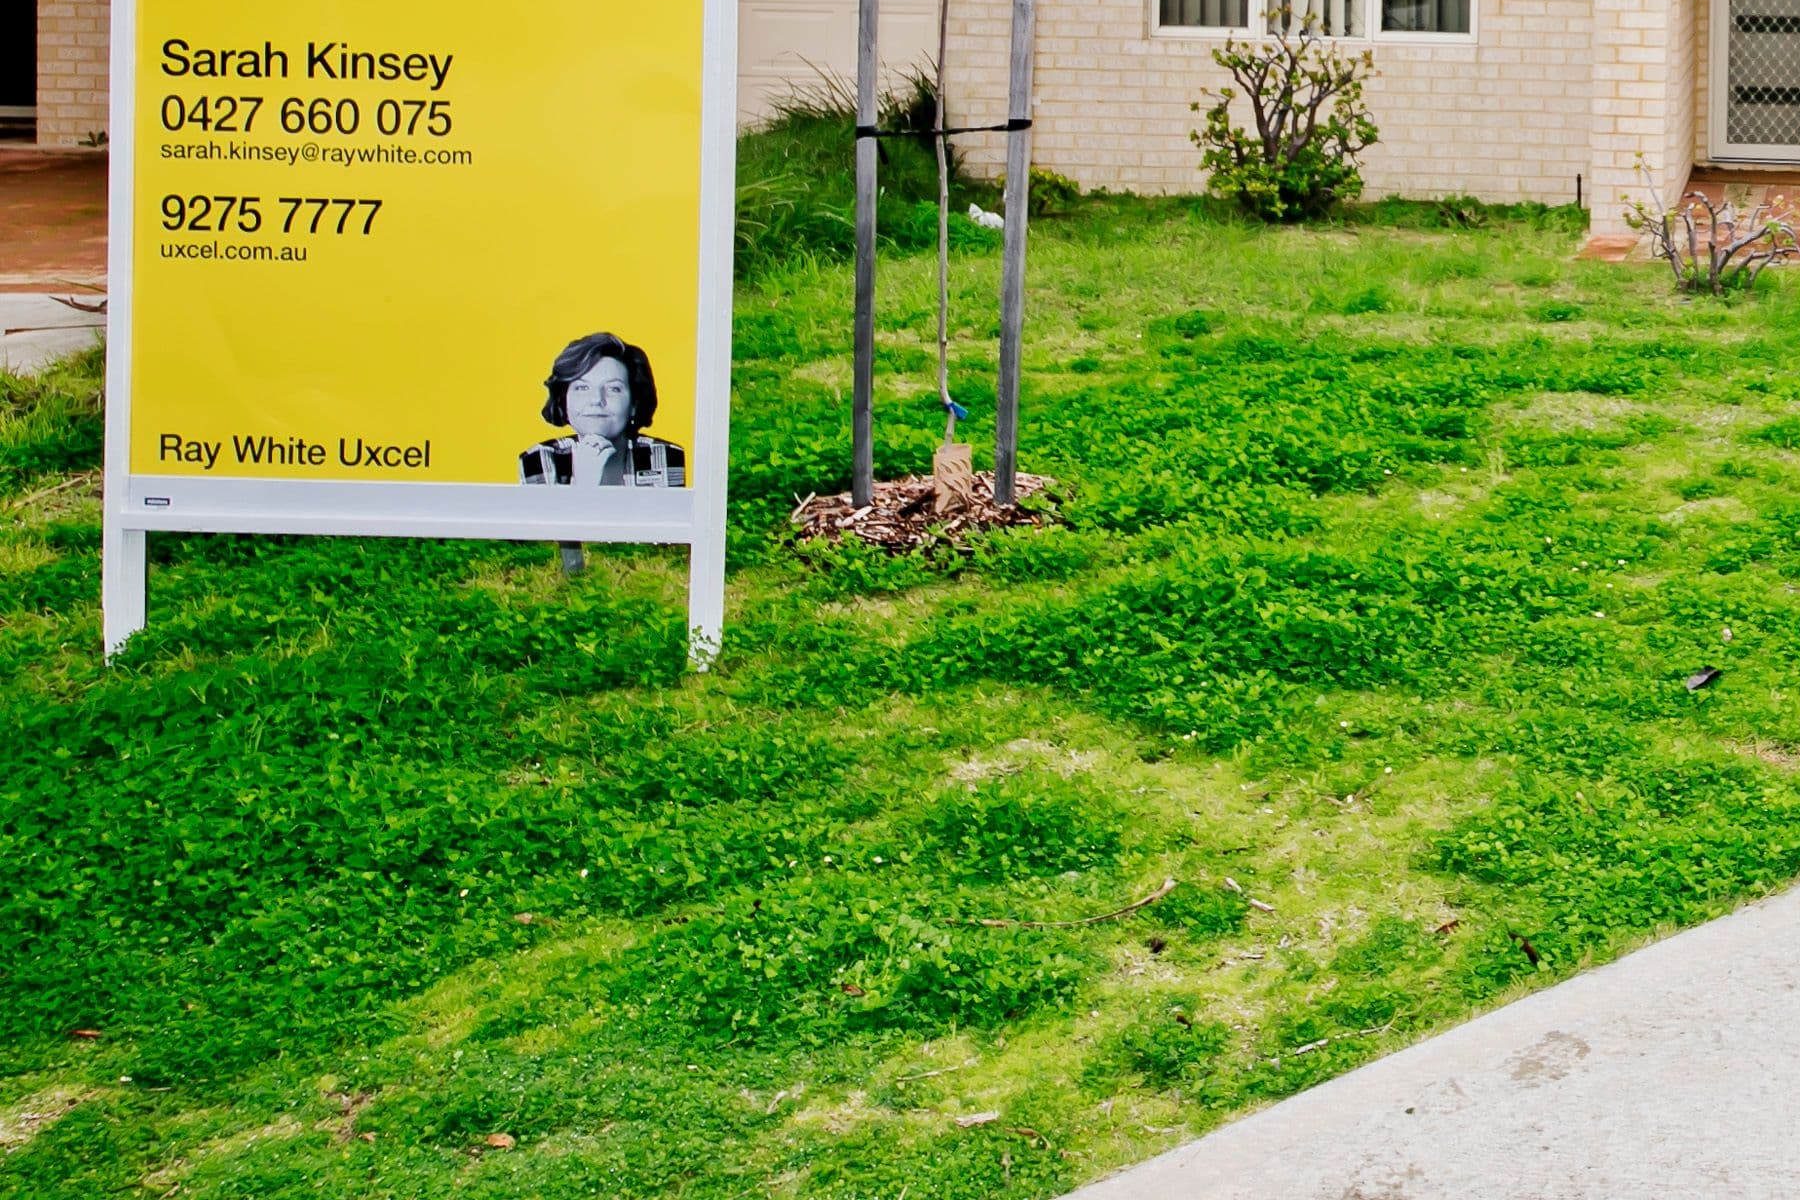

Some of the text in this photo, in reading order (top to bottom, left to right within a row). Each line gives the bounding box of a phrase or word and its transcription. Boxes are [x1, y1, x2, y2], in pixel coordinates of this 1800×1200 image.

[161, 38, 454, 91] Sarah Kinsey
[161, 94, 452, 137] 0427 660 075
[160, 140, 472, 167] sarah.kinsey@raywhite.com
[161, 194, 383, 235] 9275 7777
[160, 240, 307, 262] uxcel.com.au
[160, 433, 431, 470] Ray White Uxcel
